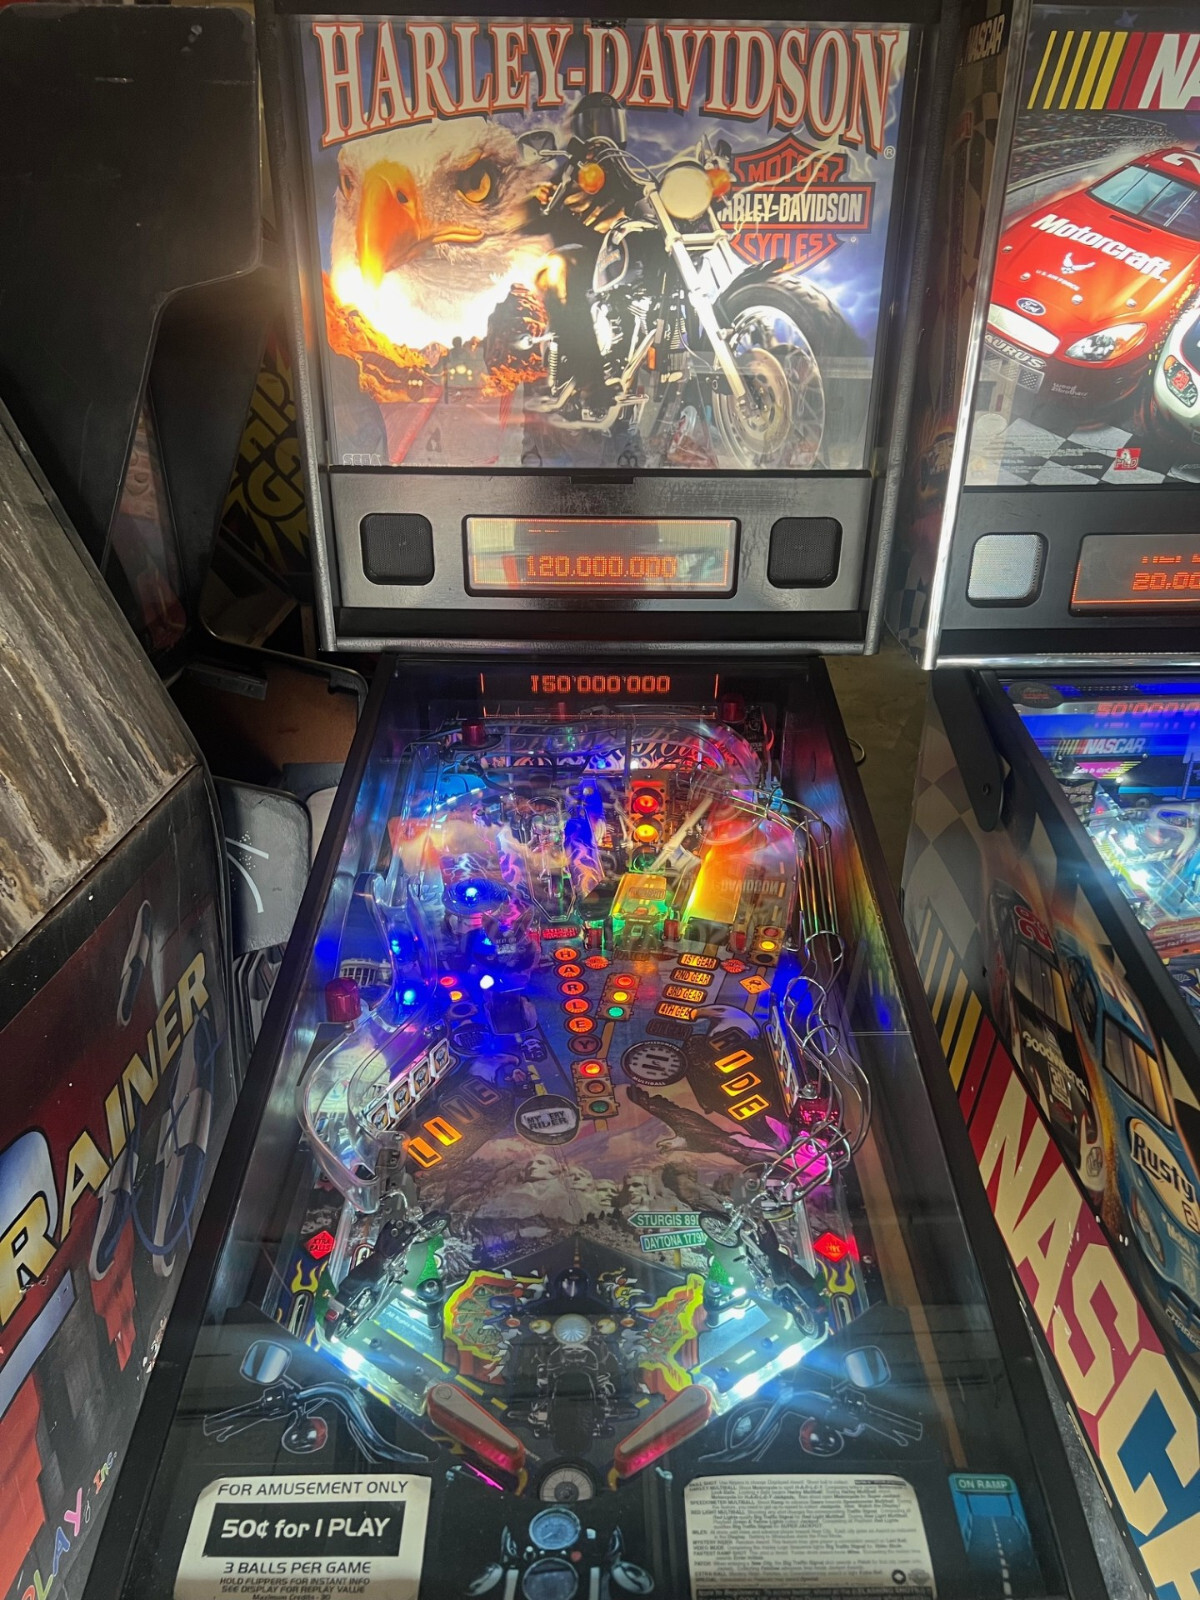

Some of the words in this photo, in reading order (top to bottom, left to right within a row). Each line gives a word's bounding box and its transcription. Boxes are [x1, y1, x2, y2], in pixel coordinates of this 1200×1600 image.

[313, 21, 900, 152] HARLEY-DAVIDSON
[748, 149, 829, 182] MOTOR
[717, 193, 863, 222] ARLEY-DAVIDSON
[1031, 213, 1171, 280] Motorcraft
[1019, 301, 1041, 314] Ford
[1083, 738, 1147, 754] NASCAR
[696, 955, 717, 968] GEAR
[691, 972, 711, 985] GEAR
[683, 988, 703, 1001] GEAR
[675, 1006, 691, 1019] GEA
[1131, 1131, 1194, 1203] Rusty
[637, 1214, 682, 1226] STURGIS
[644, 1235, 683, 1250] DAYTONA
[217, 1483, 252, 1496] FOR
[256, 1481, 363, 1496] AMUSEMENT
[369, 1480, 409, 1494] ONLY
[958, 1479, 975, 1489] ON
[977, 1479, 1009, 1489] RAMP
[221, 1518, 269, 1539] 50¢
[274, 1518, 310, 1538] for
[327, 1517, 391, 1538] PLAY
[223, 1562, 234, 1574] 3
[238, 1562, 287, 1574] BALLS
[291, 1562, 322, 1574] PER
[326, 1561, 371, 1574] GAME
[310, 1577, 347, 1585] INSTANT
[221, 1585, 239, 1593] SEE
[241, 1585, 279, 1593] DISPLAY
[280, 1585, 298, 1593] FOR
[301, 1585, 334, 1593] REPLAY
[337, 1585, 365, 1593] VALUE
